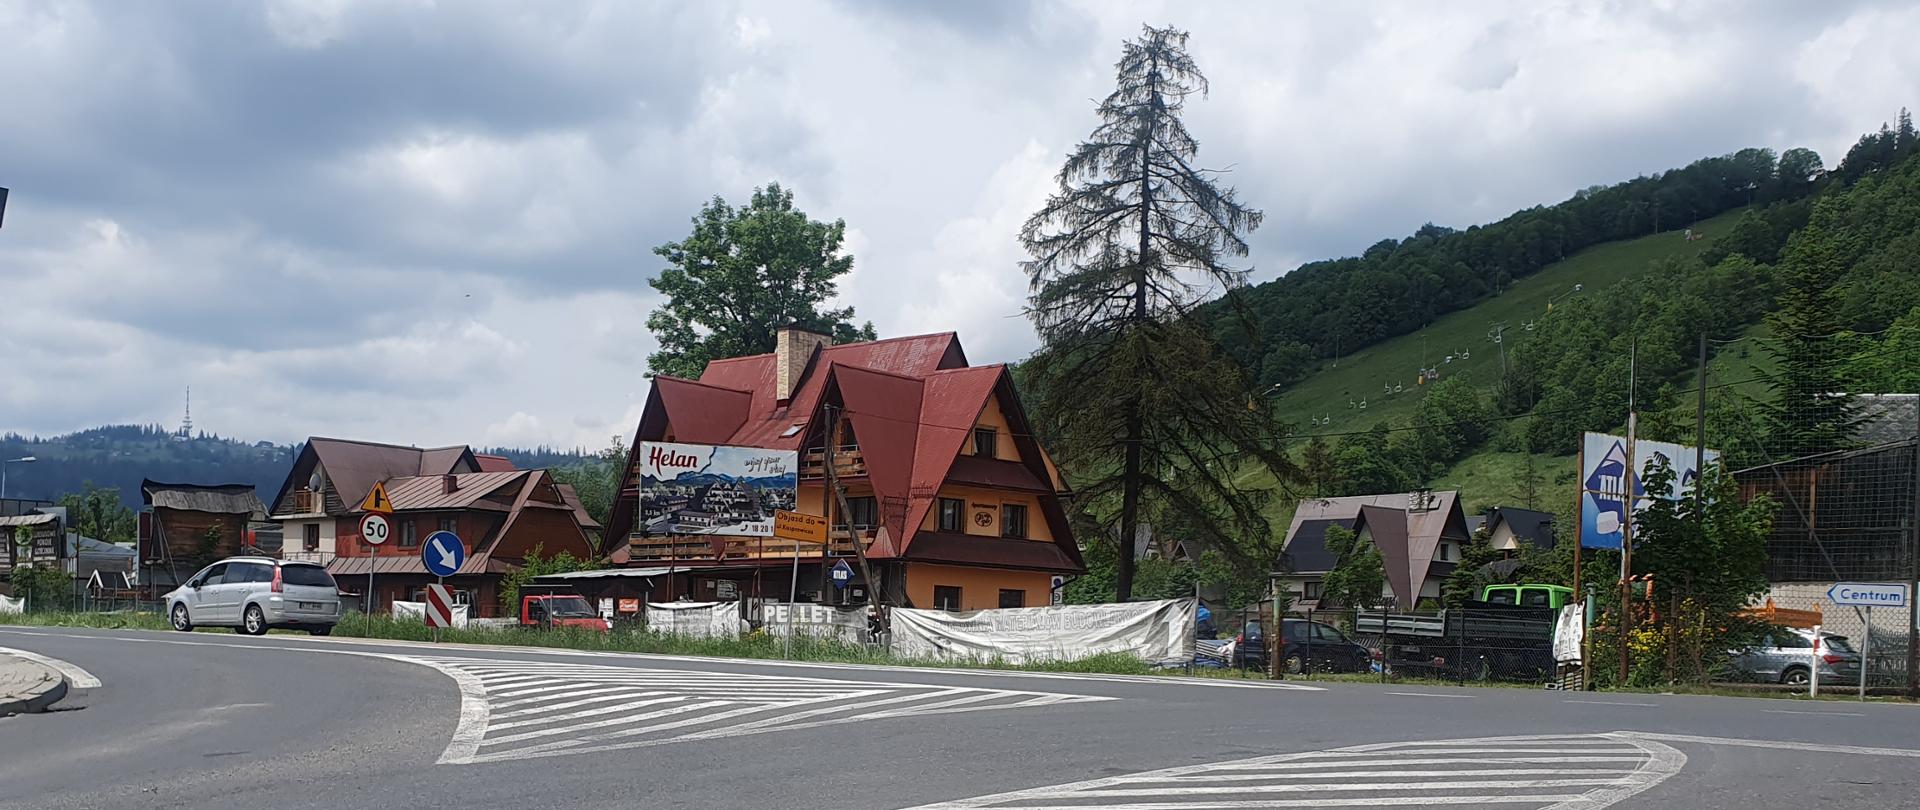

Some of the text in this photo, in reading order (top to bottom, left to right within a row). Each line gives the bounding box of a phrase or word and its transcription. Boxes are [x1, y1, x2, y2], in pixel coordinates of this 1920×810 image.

[649, 446, 698, 477] Helan
[1598, 475, 1626, 502] ATLA
[777, 511, 816, 525] Objazd do
[365, 521, 387, 538] 50
[1840, 588, 1901, 602] Centrum
